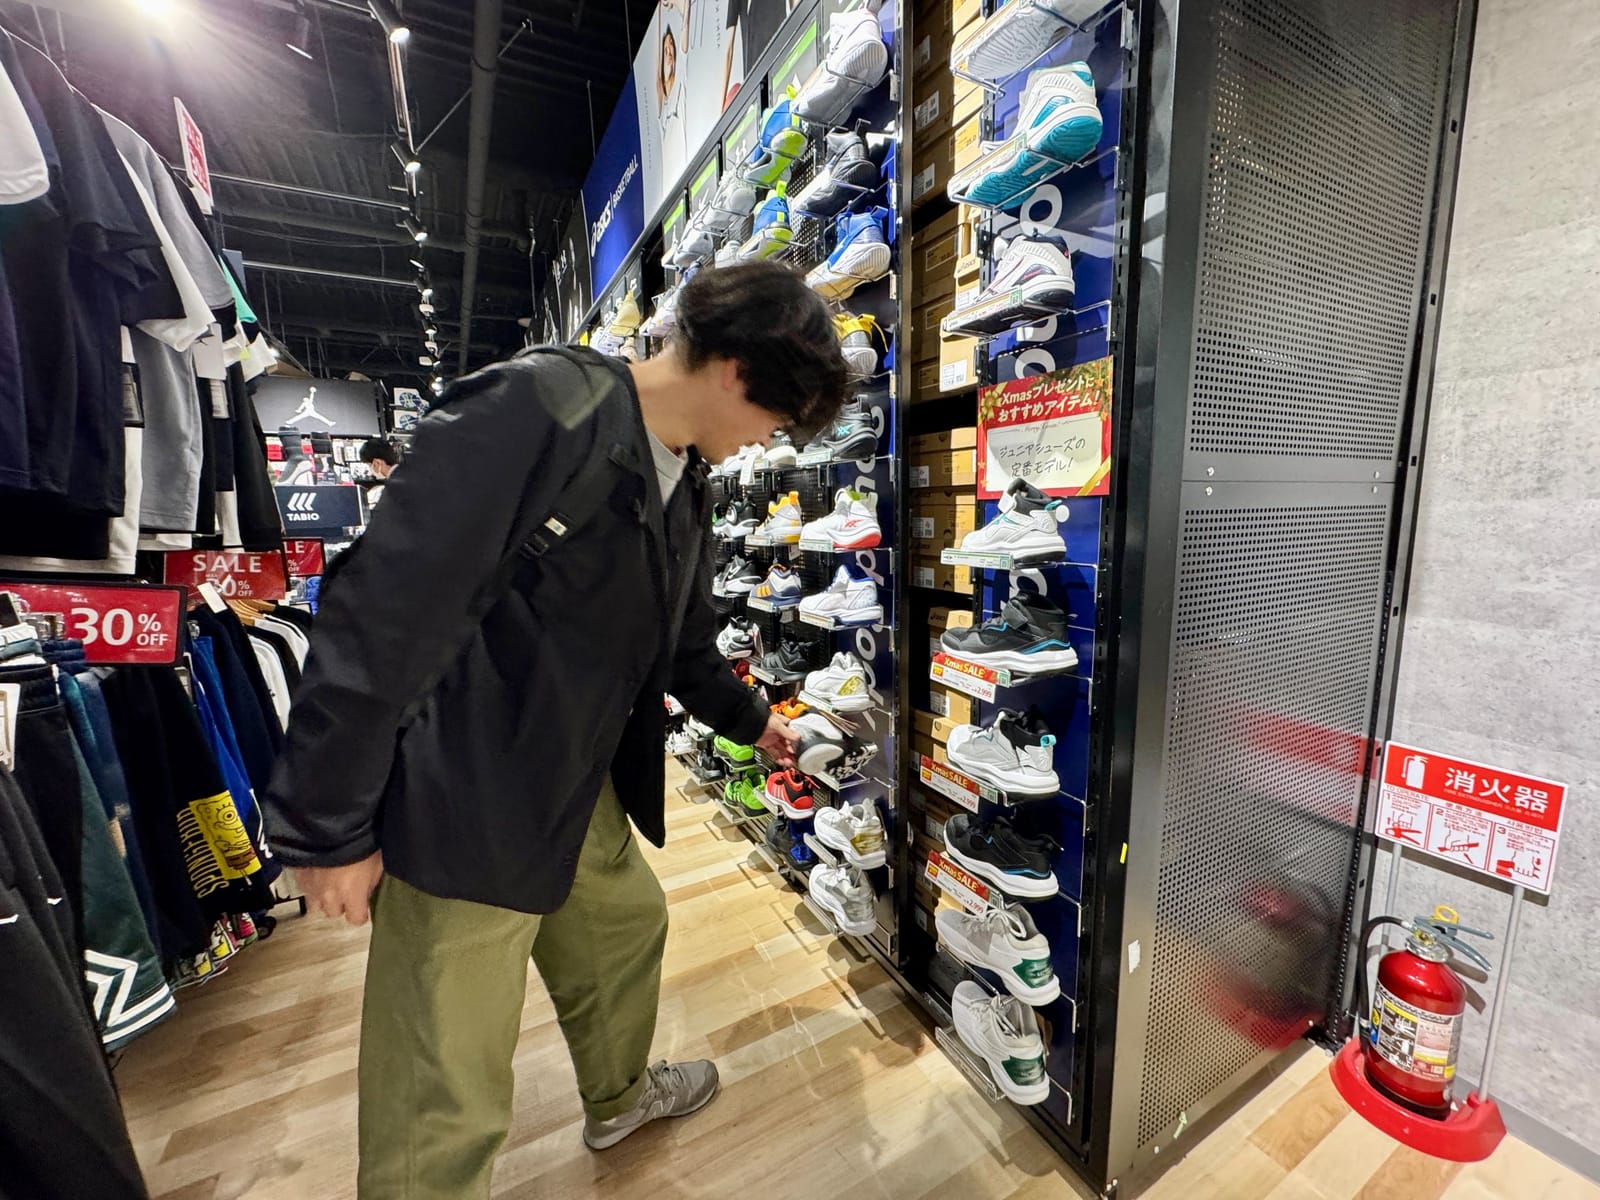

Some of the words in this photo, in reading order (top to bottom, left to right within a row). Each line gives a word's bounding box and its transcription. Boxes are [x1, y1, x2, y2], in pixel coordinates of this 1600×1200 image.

[1001, 374, 1095, 406] Xmasプレゼントに
[1000, 435, 1086, 459] ジュニアシューズの
[286, 512, 320, 521] TABIO
[192, 554, 262, 574] SALE
[237, 589, 253, 597] OFF
[136, 633, 169, 646] OFF
[1386, 784, 1395, 792] TO
[1396, 787, 1429, 800] OPERATE
[1444, 767, 1549, 814] 消火器
[1436, 808, 1444, 816] 2
[1497, 826, 1506, 834] 3
